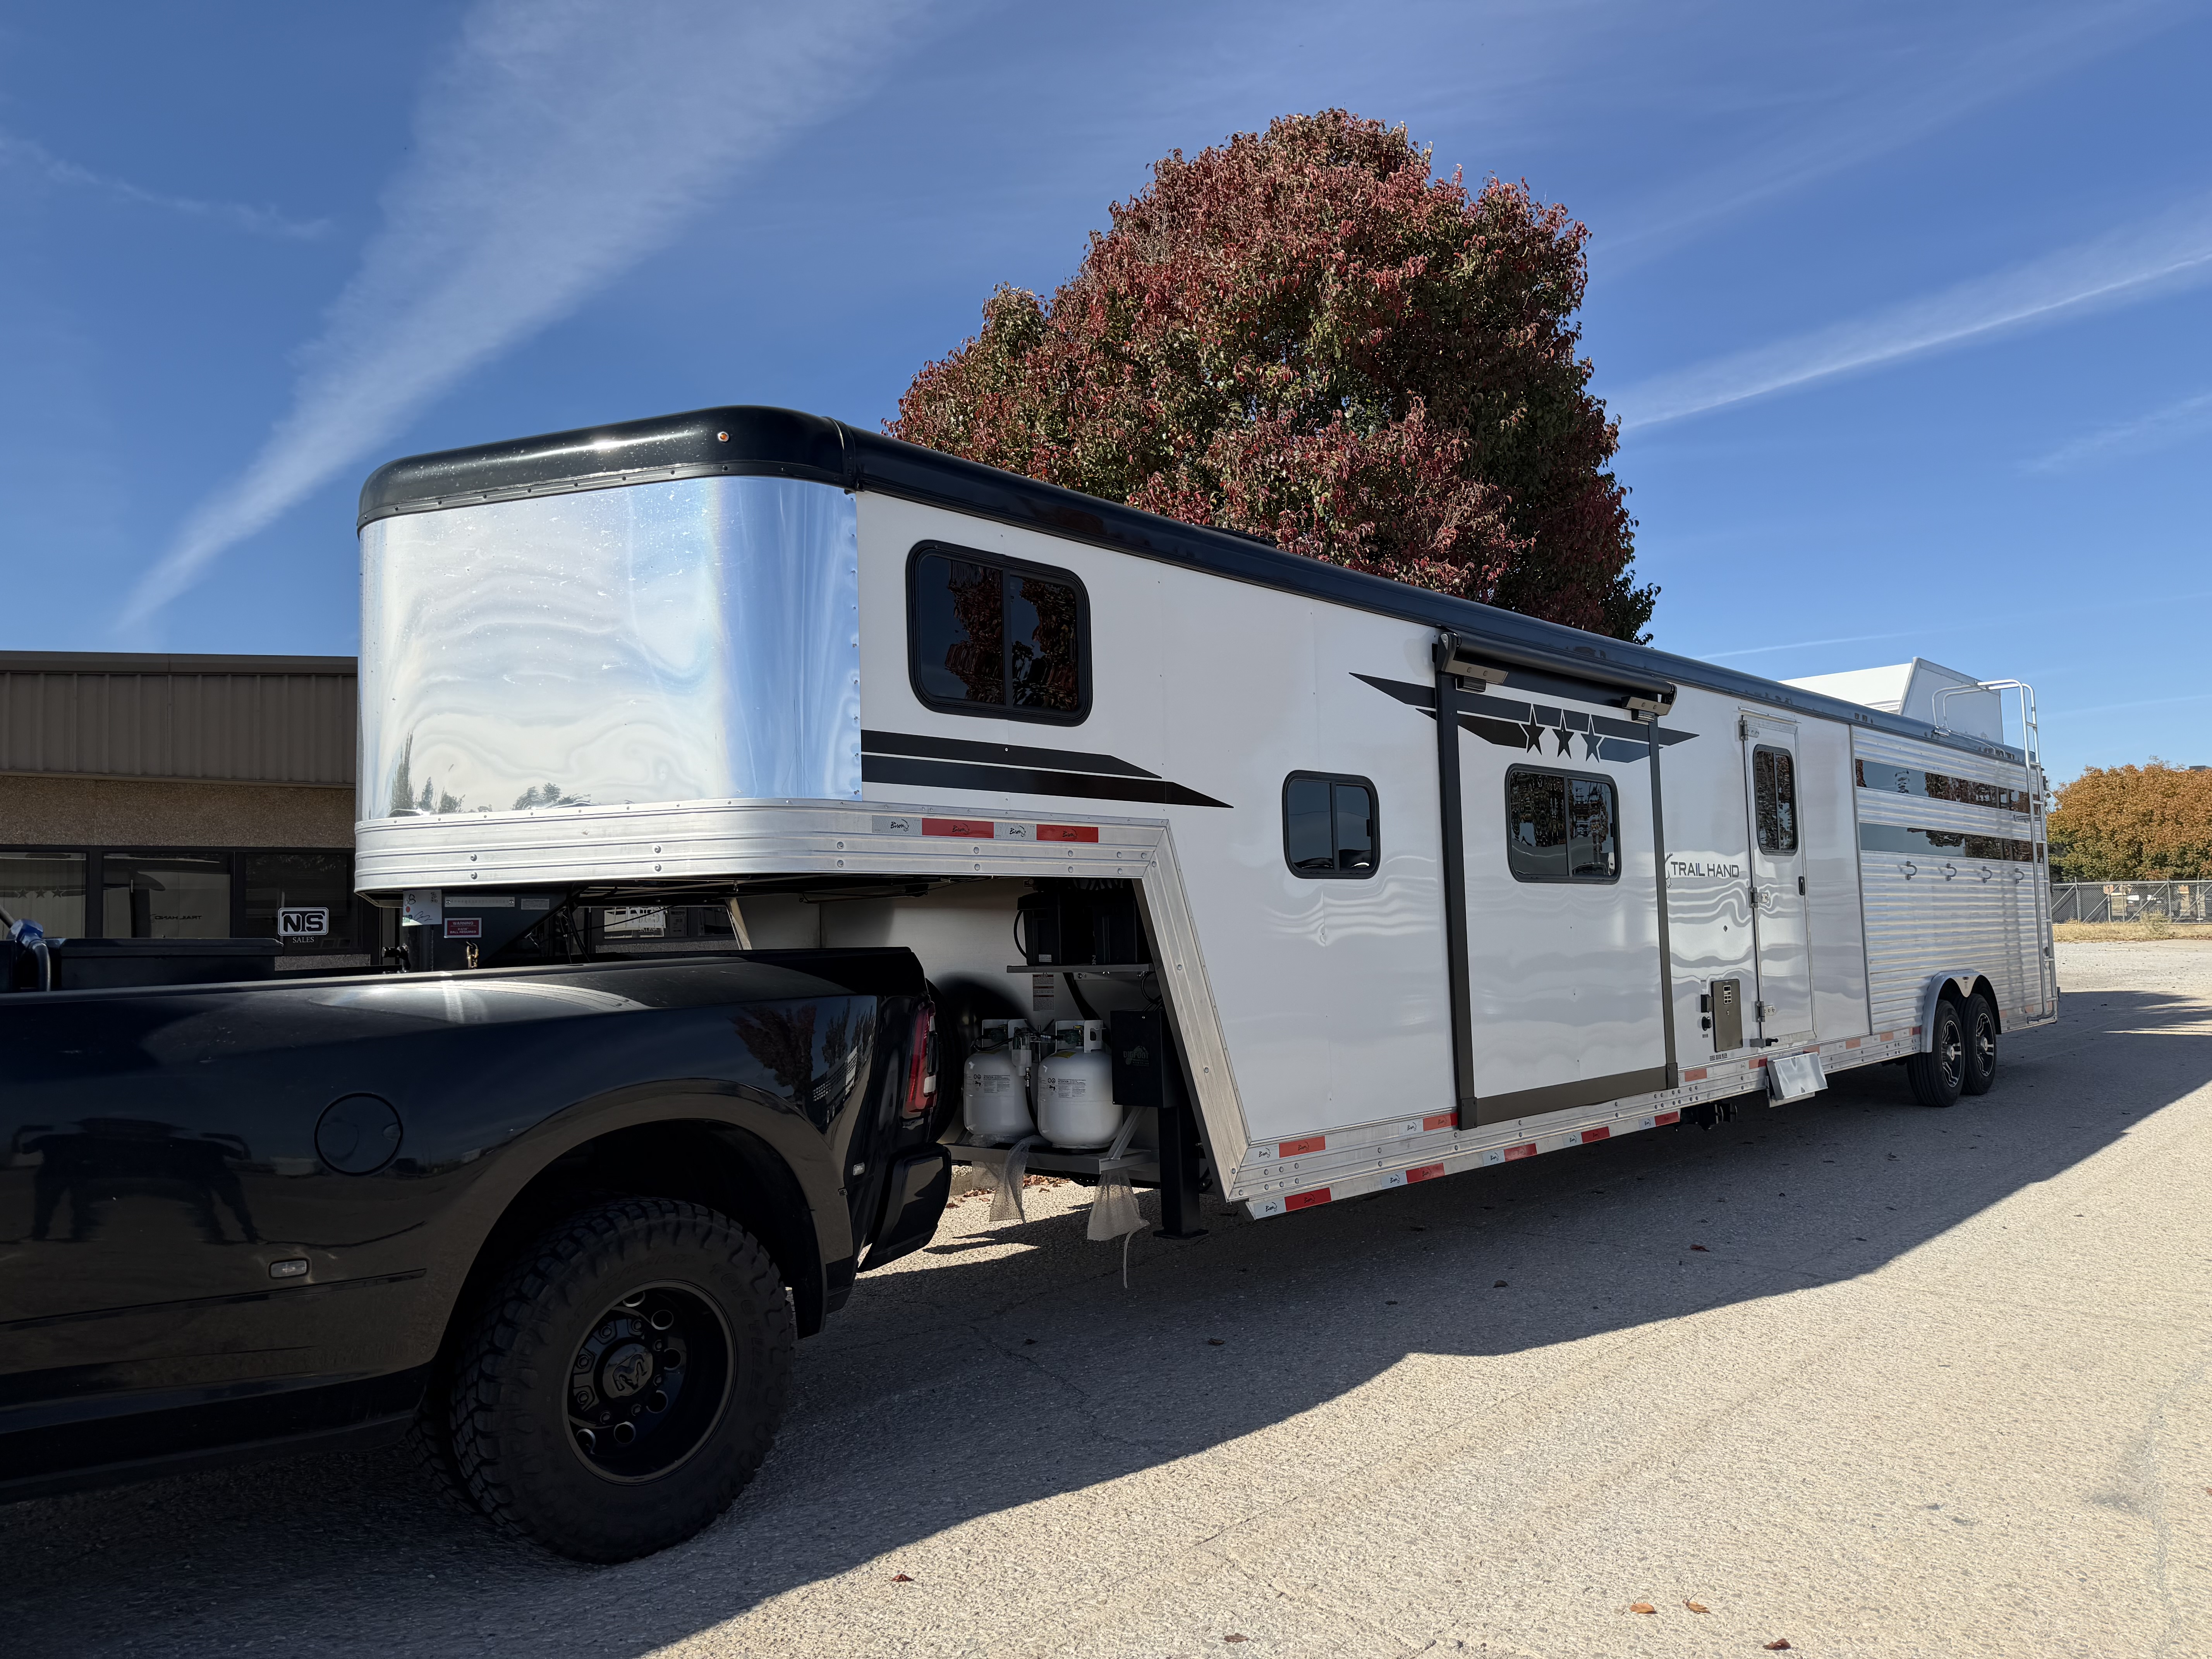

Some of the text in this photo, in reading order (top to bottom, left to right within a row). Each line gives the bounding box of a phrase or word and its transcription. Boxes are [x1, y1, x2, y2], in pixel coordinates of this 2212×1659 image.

[1671, 861, 1739, 878] TRAIL HAND
[282, 910, 325, 932] NTS
[1123, 1051, 1149, 1059] BIGFOOT
